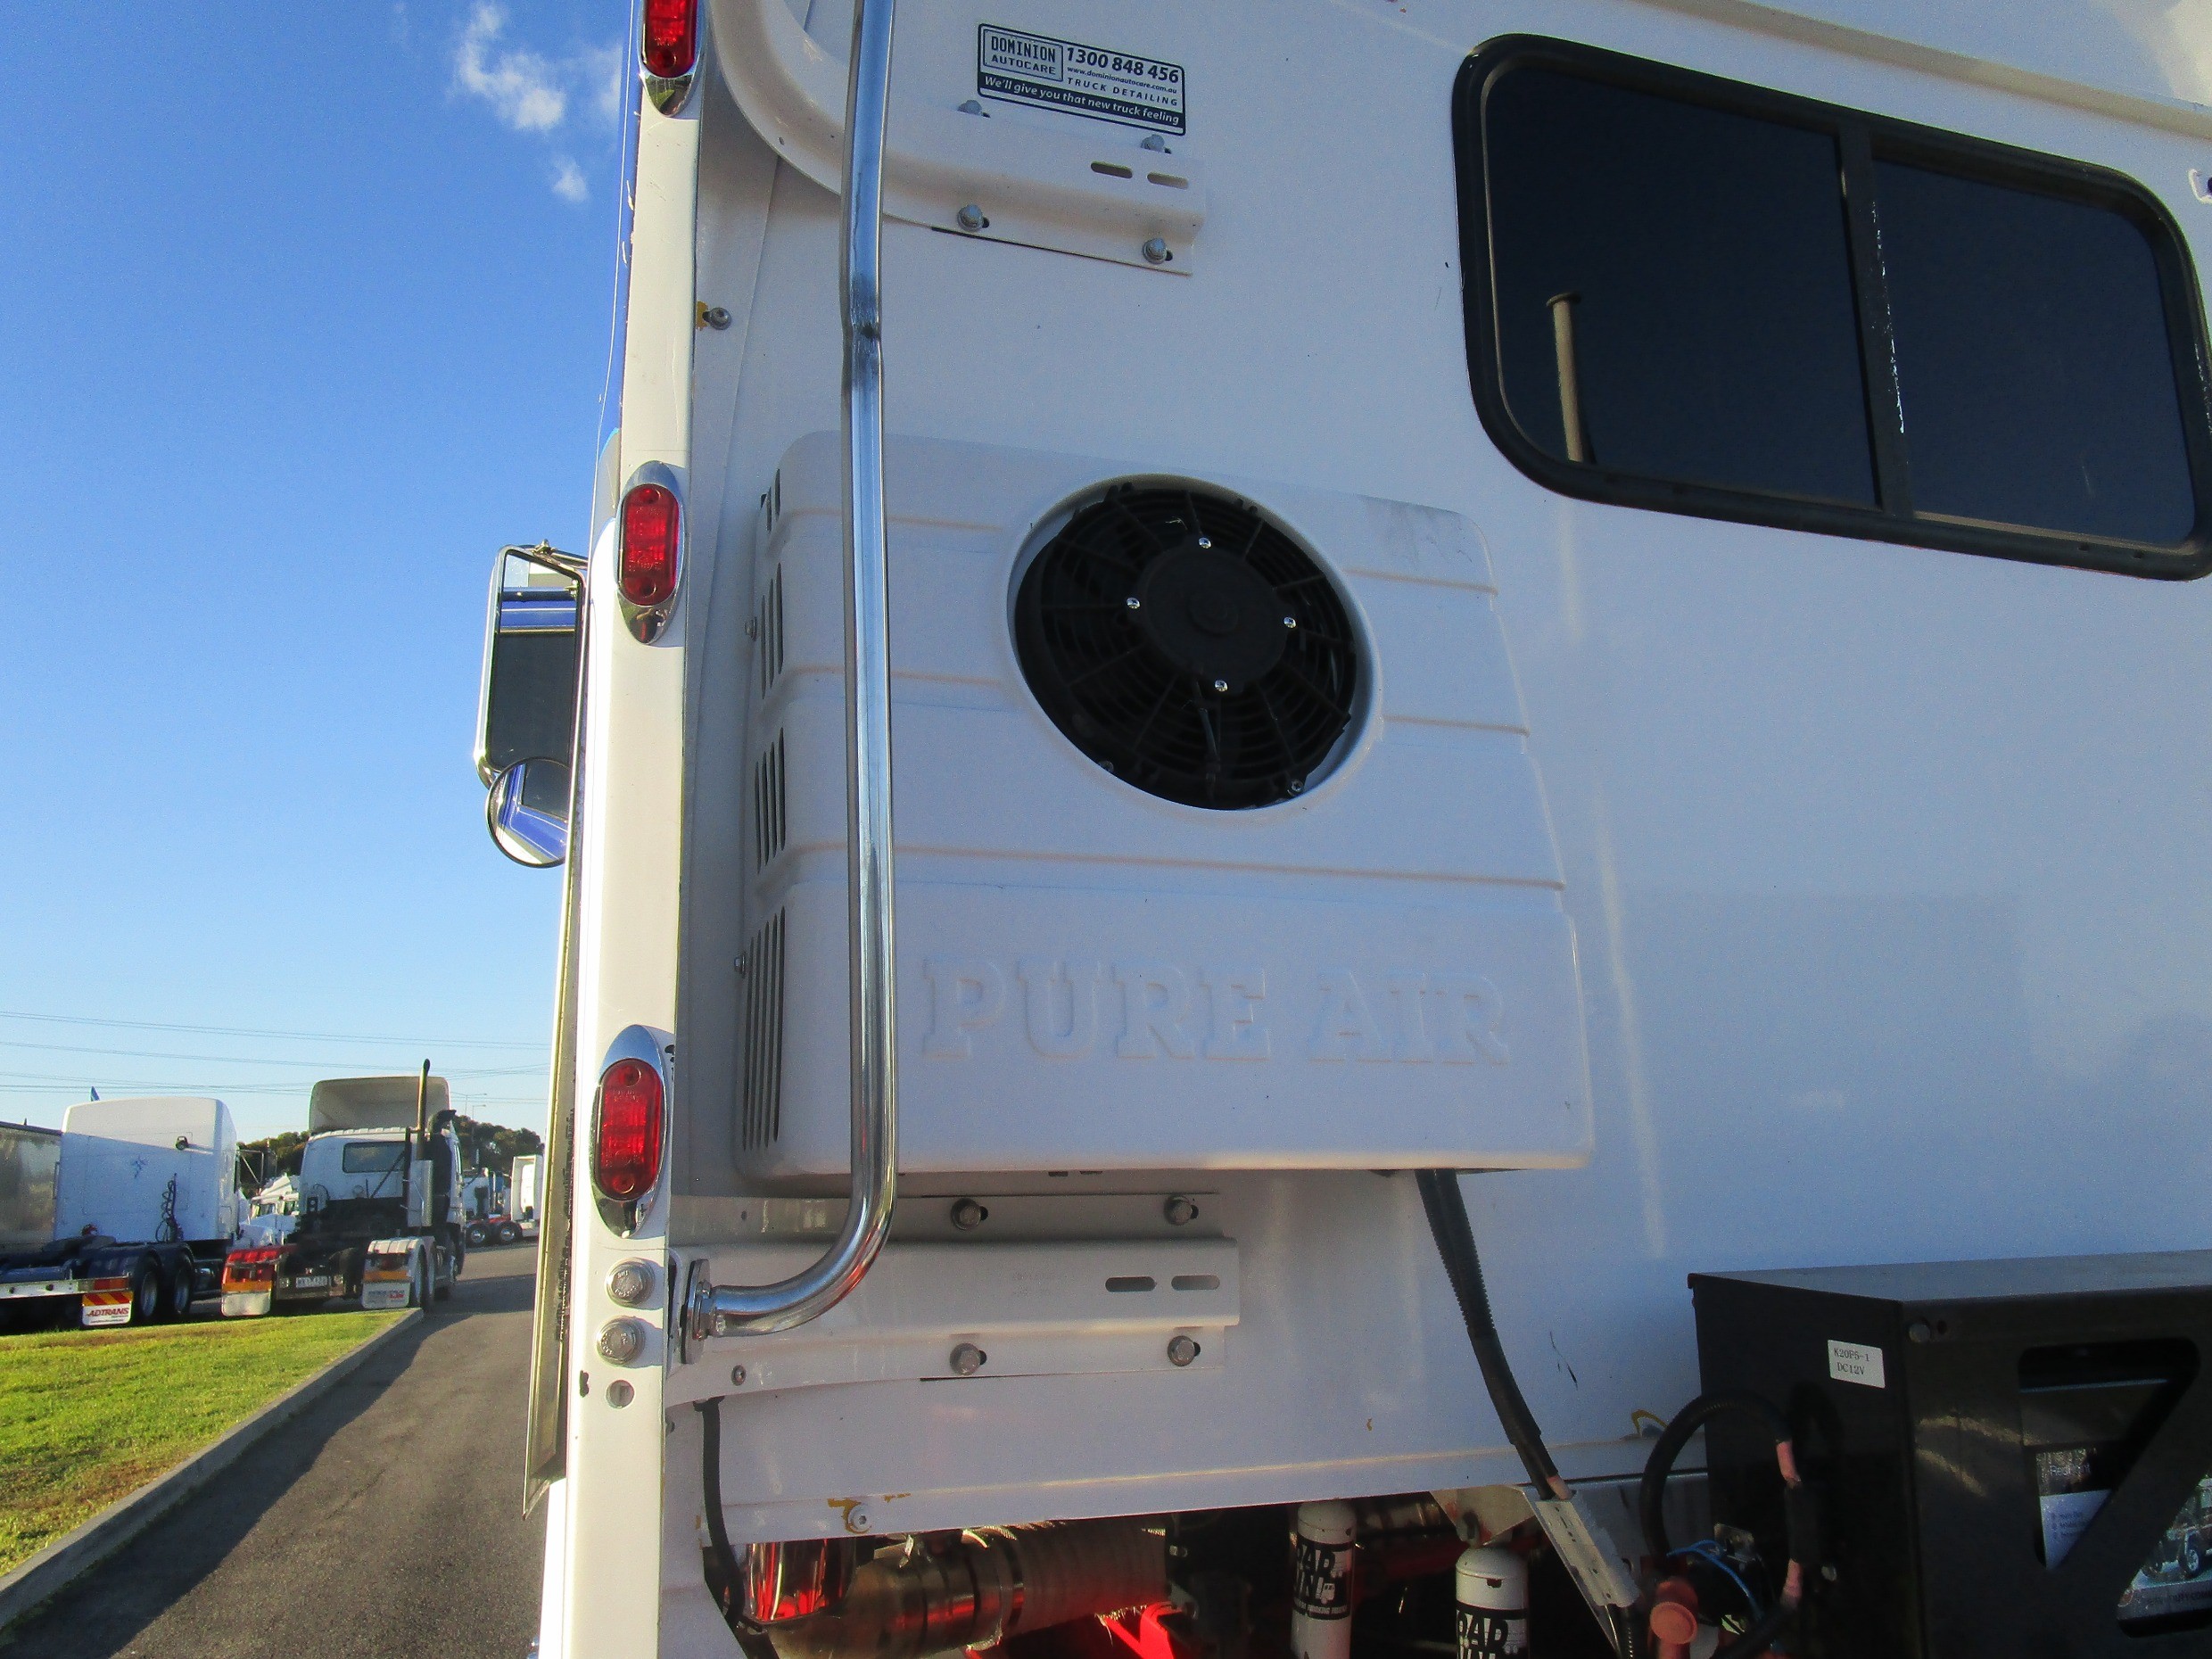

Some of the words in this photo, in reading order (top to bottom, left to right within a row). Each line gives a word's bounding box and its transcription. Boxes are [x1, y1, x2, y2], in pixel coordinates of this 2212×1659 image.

[992, 36, 1056, 62] DOMINION
[991, 54, 1056, 75] AUTOCARE
[1067, 47, 1109, 68] 1300
[1111, 57, 1144, 76] 848
[1147, 64, 1179, 83] 456
[1067, 67, 1177, 94] www.dominionautocare.com.au
[1067, 77, 1107, 92] TRUCK
[1112, 87, 1178, 106] DETAILING
[985, 76, 1012, 90] We'll
[1013, 83, 1037, 95] give
[1039, 89, 1061, 100] you
[1062, 93, 1086, 104] that
[1087, 97, 1111, 110] new
[1112, 102, 1141, 116] truck
[1142, 108, 1180, 126] feeling
[921, 958, 1271, 1061] PURE
[1307, 968, 1510, 1066] AIR
[87, 1307, 129, 1316] ADTRANS
[1836, 1362, 1865, 1374] DC12V
